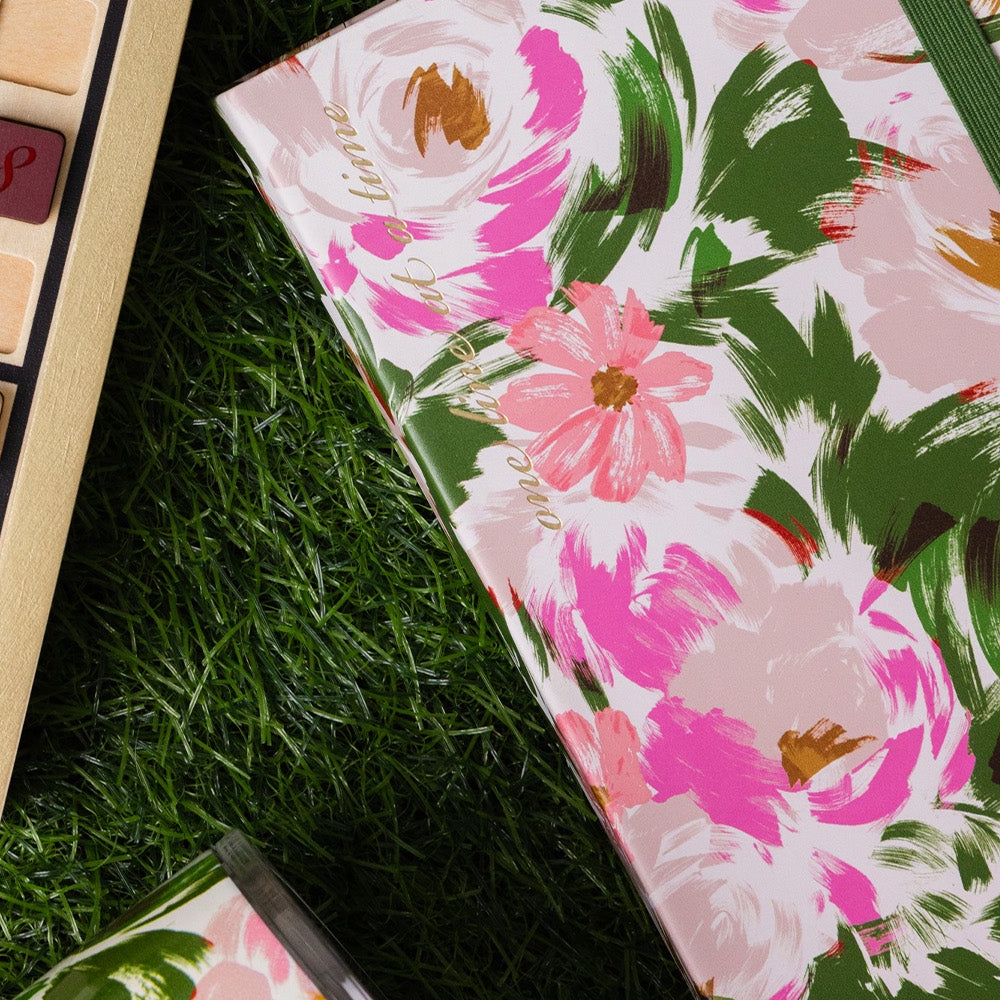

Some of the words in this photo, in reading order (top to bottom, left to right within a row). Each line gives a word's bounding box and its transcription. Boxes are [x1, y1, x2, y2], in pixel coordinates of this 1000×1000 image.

[324, 102, 391, 203] time
[384, 214, 414, 244] a
[391, 258, 450, 315] at
[431, 330, 509, 424] line
[490, 441, 562, 530] one
